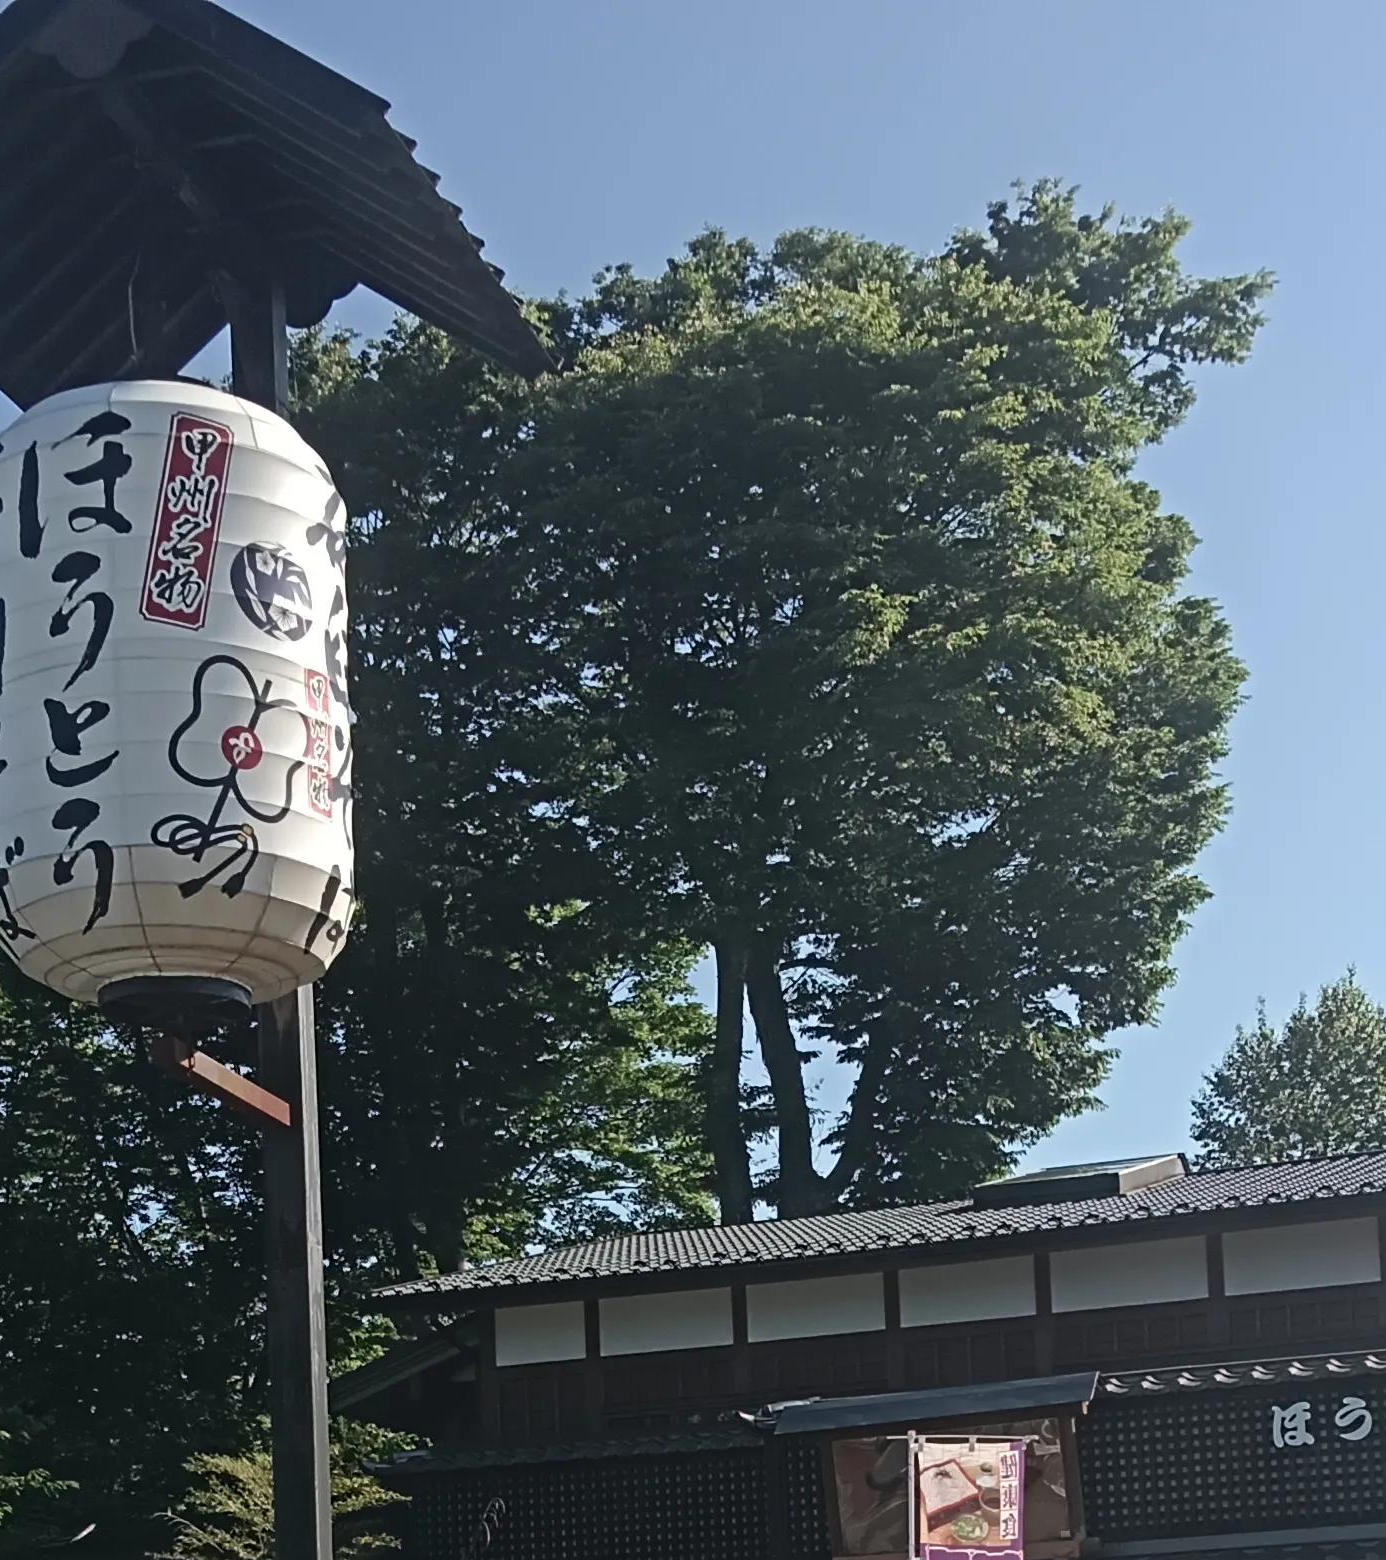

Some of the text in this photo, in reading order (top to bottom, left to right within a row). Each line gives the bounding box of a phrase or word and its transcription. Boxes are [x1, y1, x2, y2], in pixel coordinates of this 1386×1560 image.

[18, 411, 134, 934] ほうとう
[151, 428, 222, 614] 甲州名物
